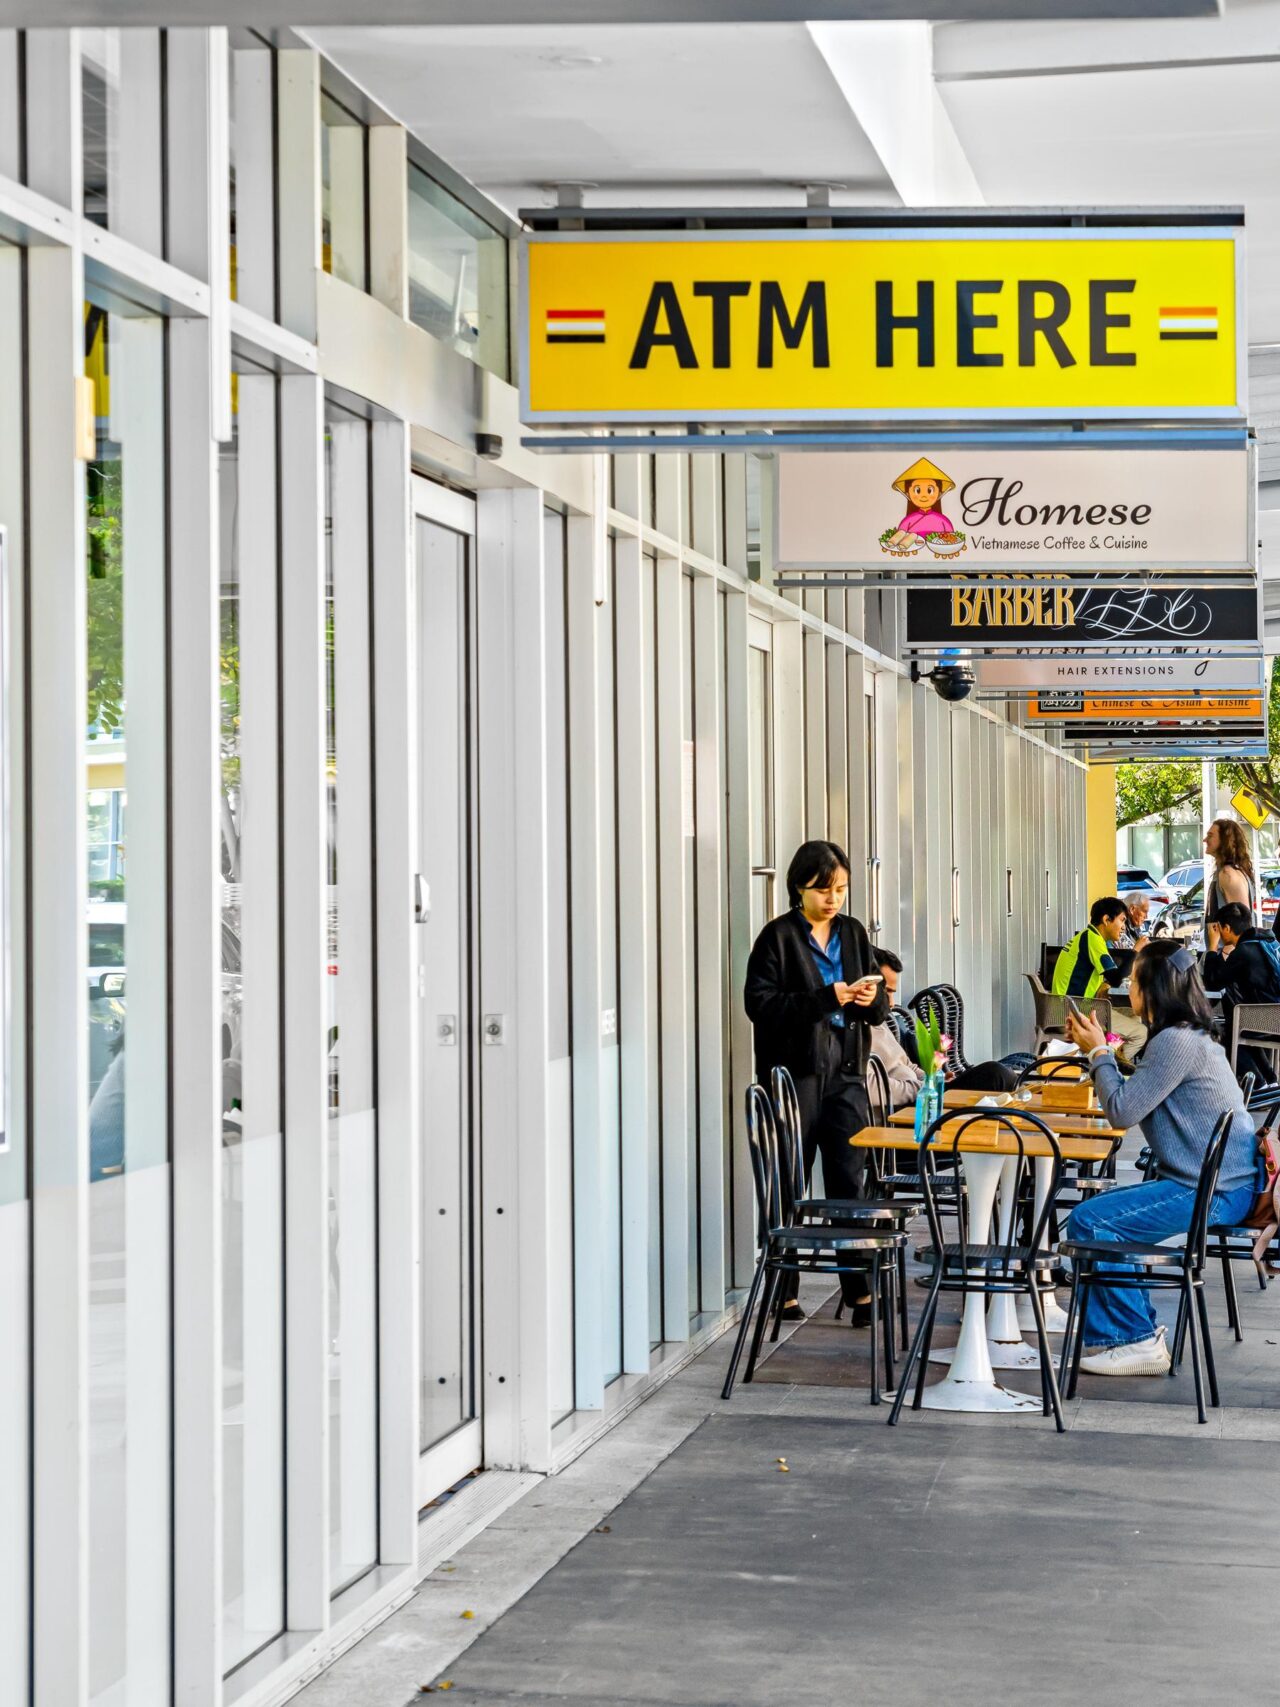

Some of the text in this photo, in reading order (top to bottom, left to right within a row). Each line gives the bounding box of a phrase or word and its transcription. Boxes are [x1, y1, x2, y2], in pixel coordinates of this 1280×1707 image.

[628, 278, 1138, 370] ATM HERE
[959, 476, 1152, 527] Homese
[970, 535, 1149, 550] Vietnamese Coffee & Cuisine
[950, 573, 1076, 627] BARBER
[1057, 665, 1175, 676] HAIR EXTENSIONS
